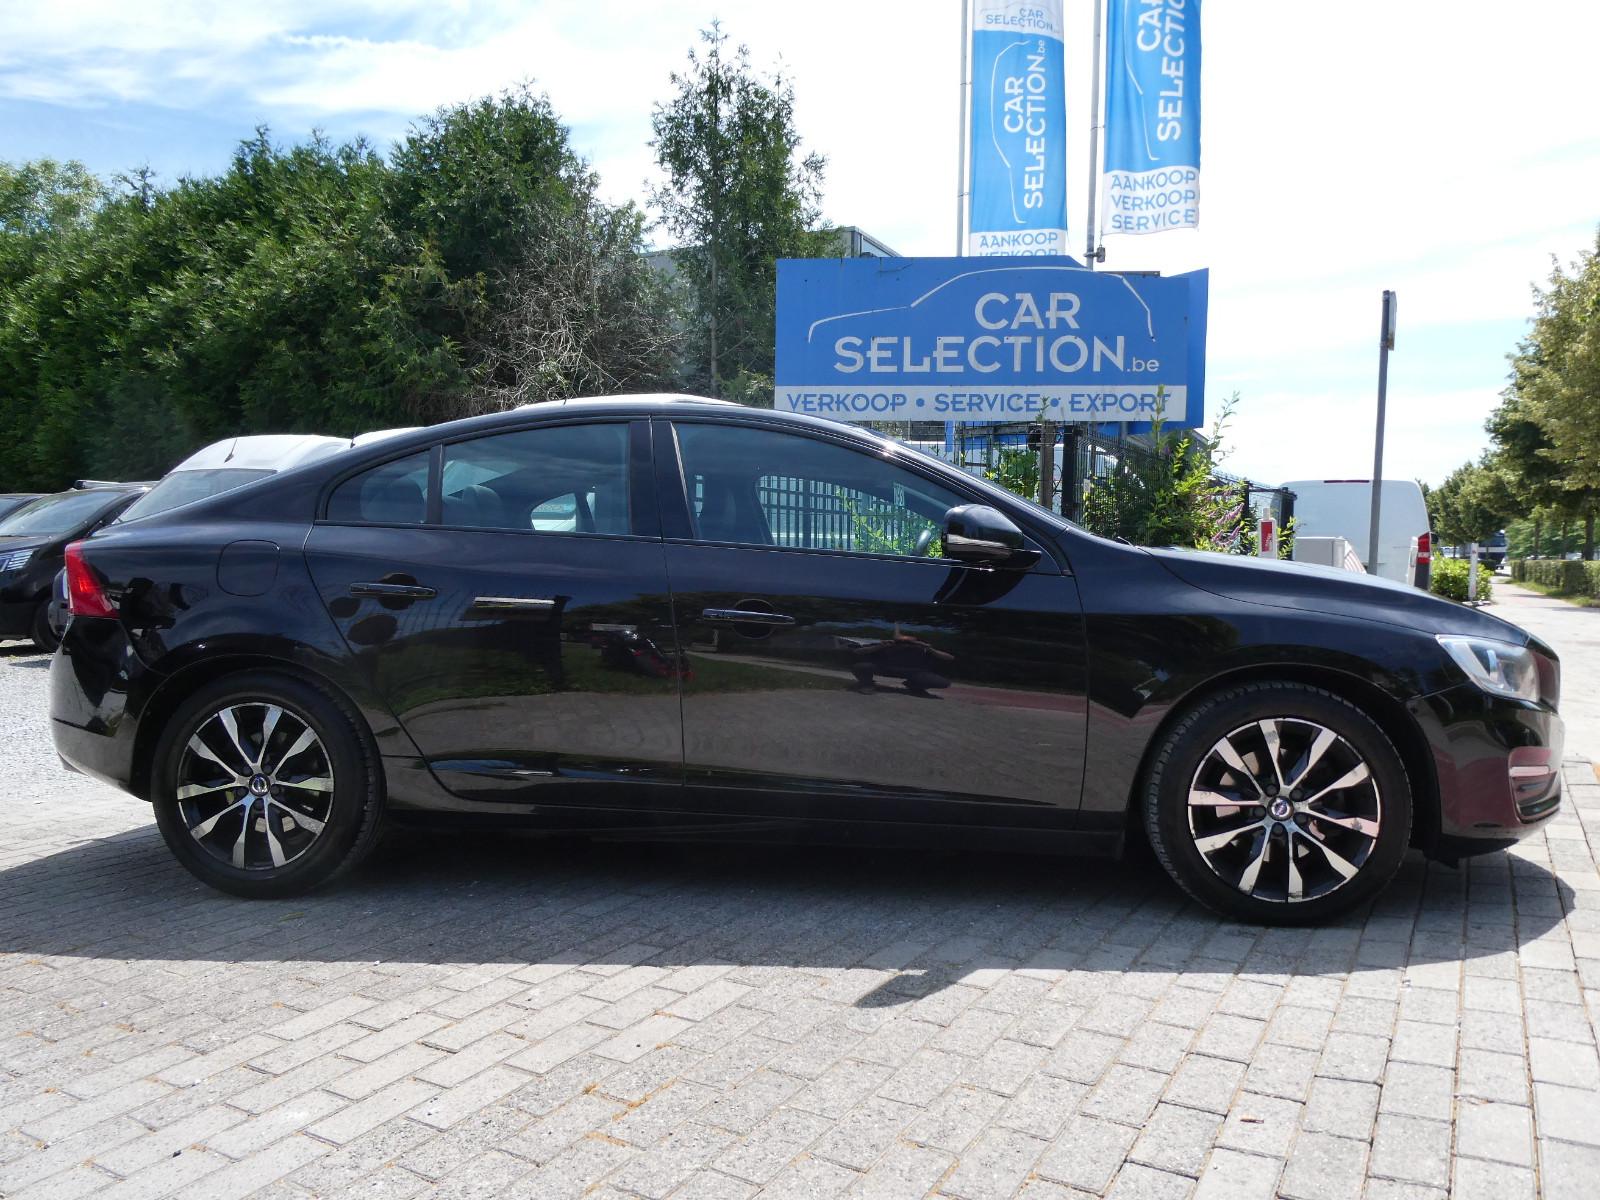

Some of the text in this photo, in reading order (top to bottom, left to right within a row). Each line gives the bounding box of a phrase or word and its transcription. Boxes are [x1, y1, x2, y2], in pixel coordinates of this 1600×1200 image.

[1019, 8, 1044, 18] CAR
[1003, 76, 1024, 133] CAR
[1111, 170, 1196, 190] AANKOOP
[1111, 190, 1196, 211] VERKOOP
[1111, 209, 1196, 230] SERVICE
[979, 232, 1058, 248] AANKOOP
[974, 292, 1080, 330] CAR
[833, 335, 1160, 374] SELECTION.be
[787, 393, 907, 413] VERKOOP
[934, 393, 1041, 412] SERVICE
